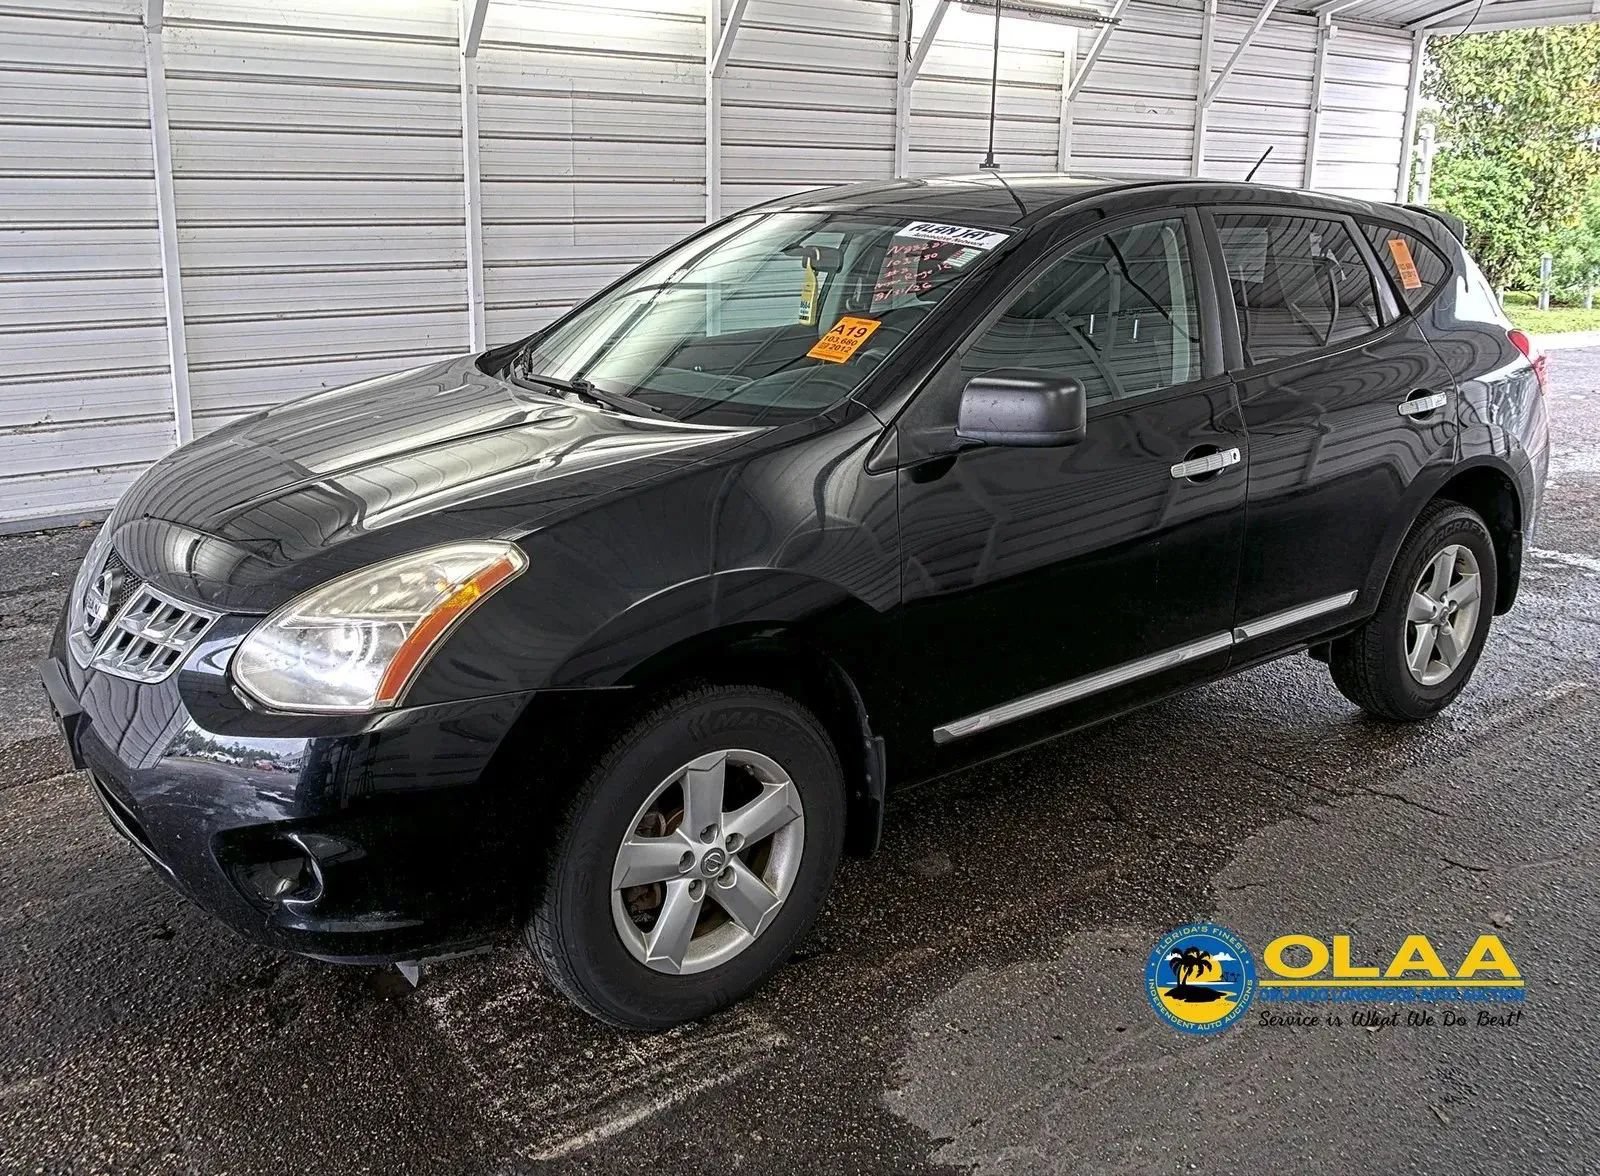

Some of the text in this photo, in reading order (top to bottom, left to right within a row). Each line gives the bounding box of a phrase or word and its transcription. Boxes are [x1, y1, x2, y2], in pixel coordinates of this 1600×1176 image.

[909, 224, 998, 241] ALAN JAY
[830, 324, 867, 338] A19
[823, 335, 858, 347] 103,680
[829, 344, 852, 354] 2012
